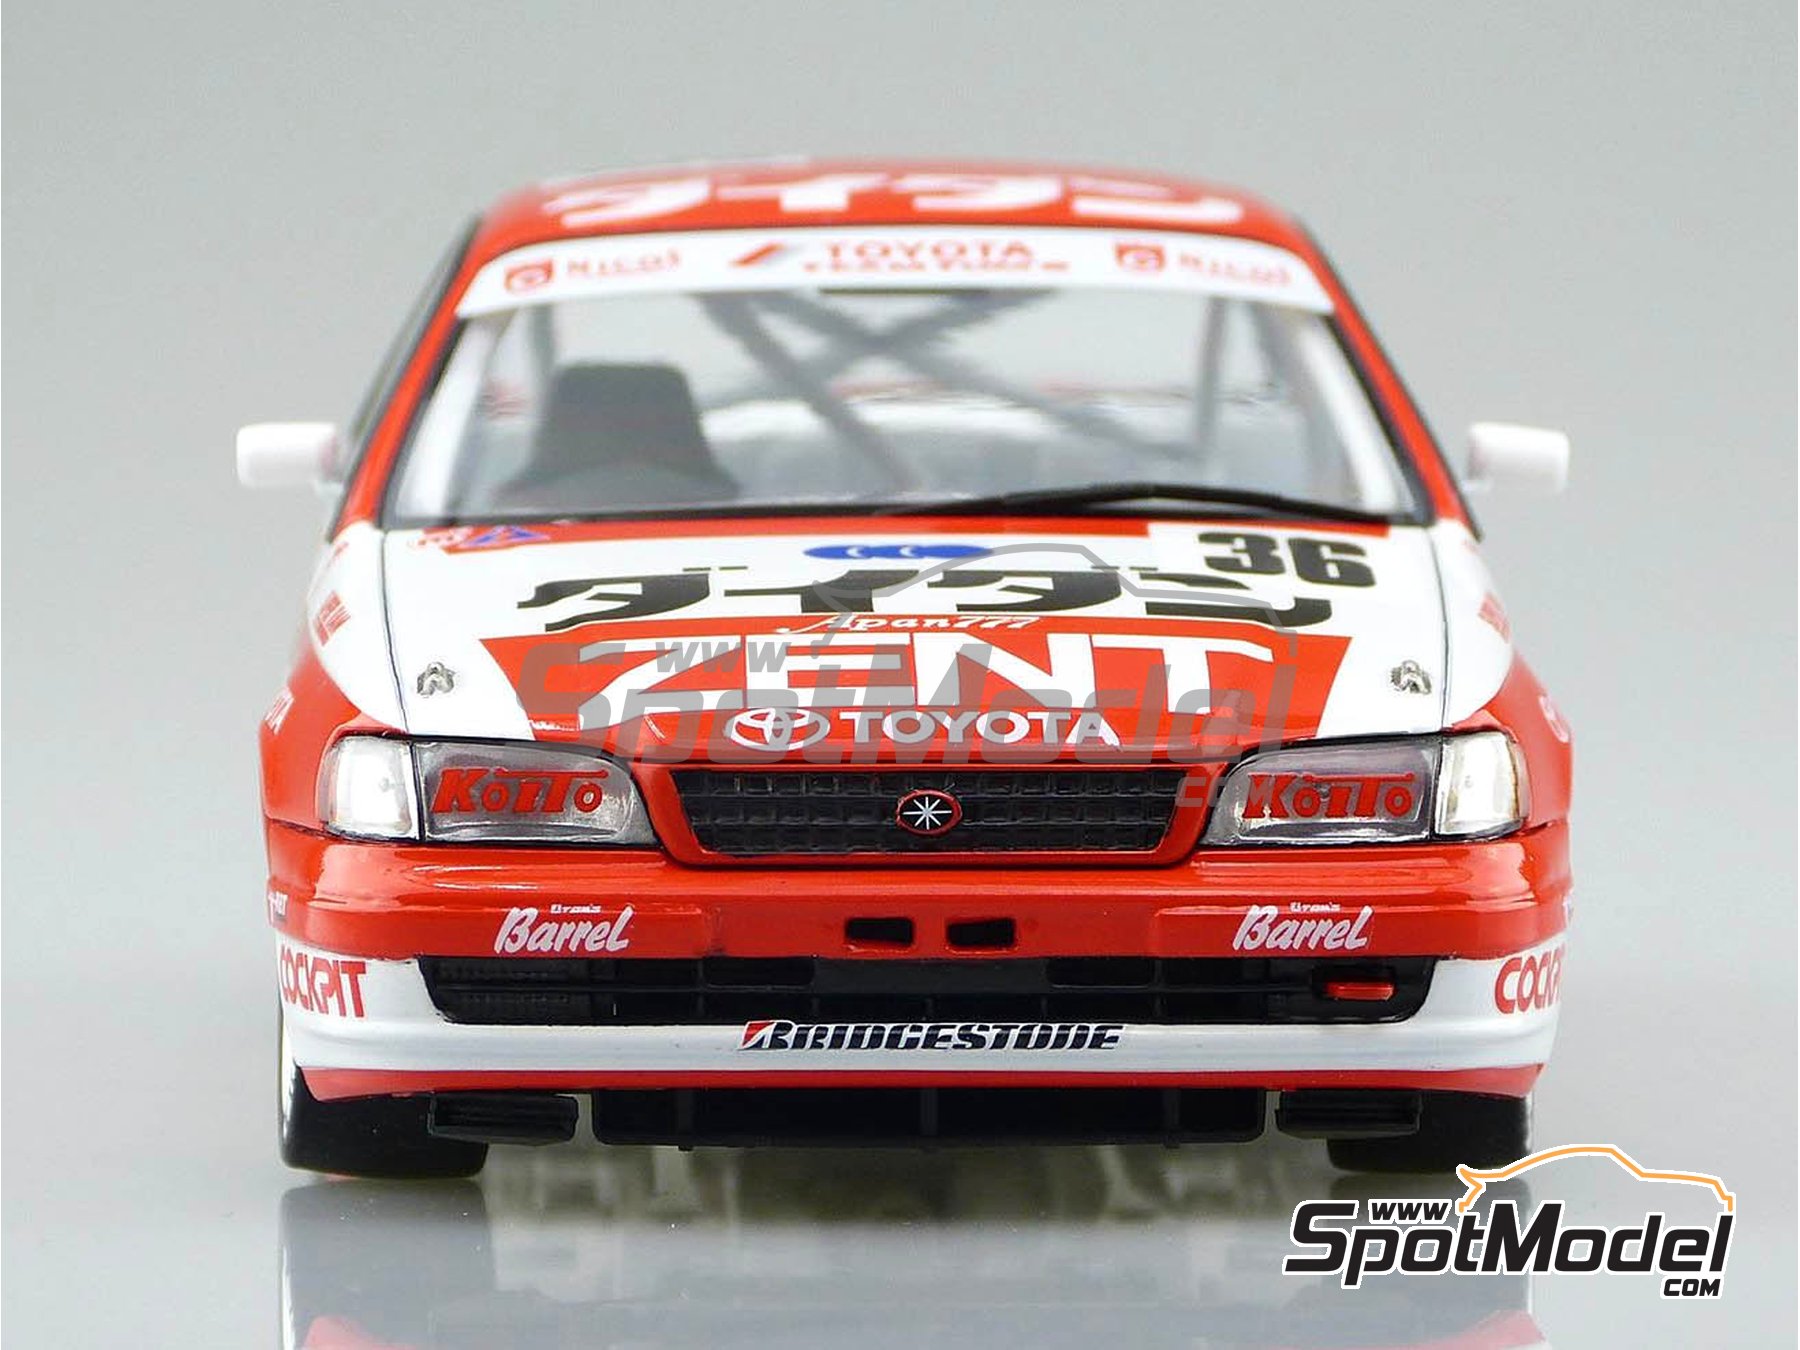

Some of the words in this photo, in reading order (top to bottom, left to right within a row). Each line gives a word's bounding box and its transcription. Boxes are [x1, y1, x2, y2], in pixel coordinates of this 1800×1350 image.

[826, 237, 1035, 260] TOYOTA
[1198, 532, 1377, 588] 36
[577, 631, 1275, 731] ZENT
[840, 711, 1122, 750] TOYOTA
[742, 1021, 1124, 1051] BRIDGESTONE
